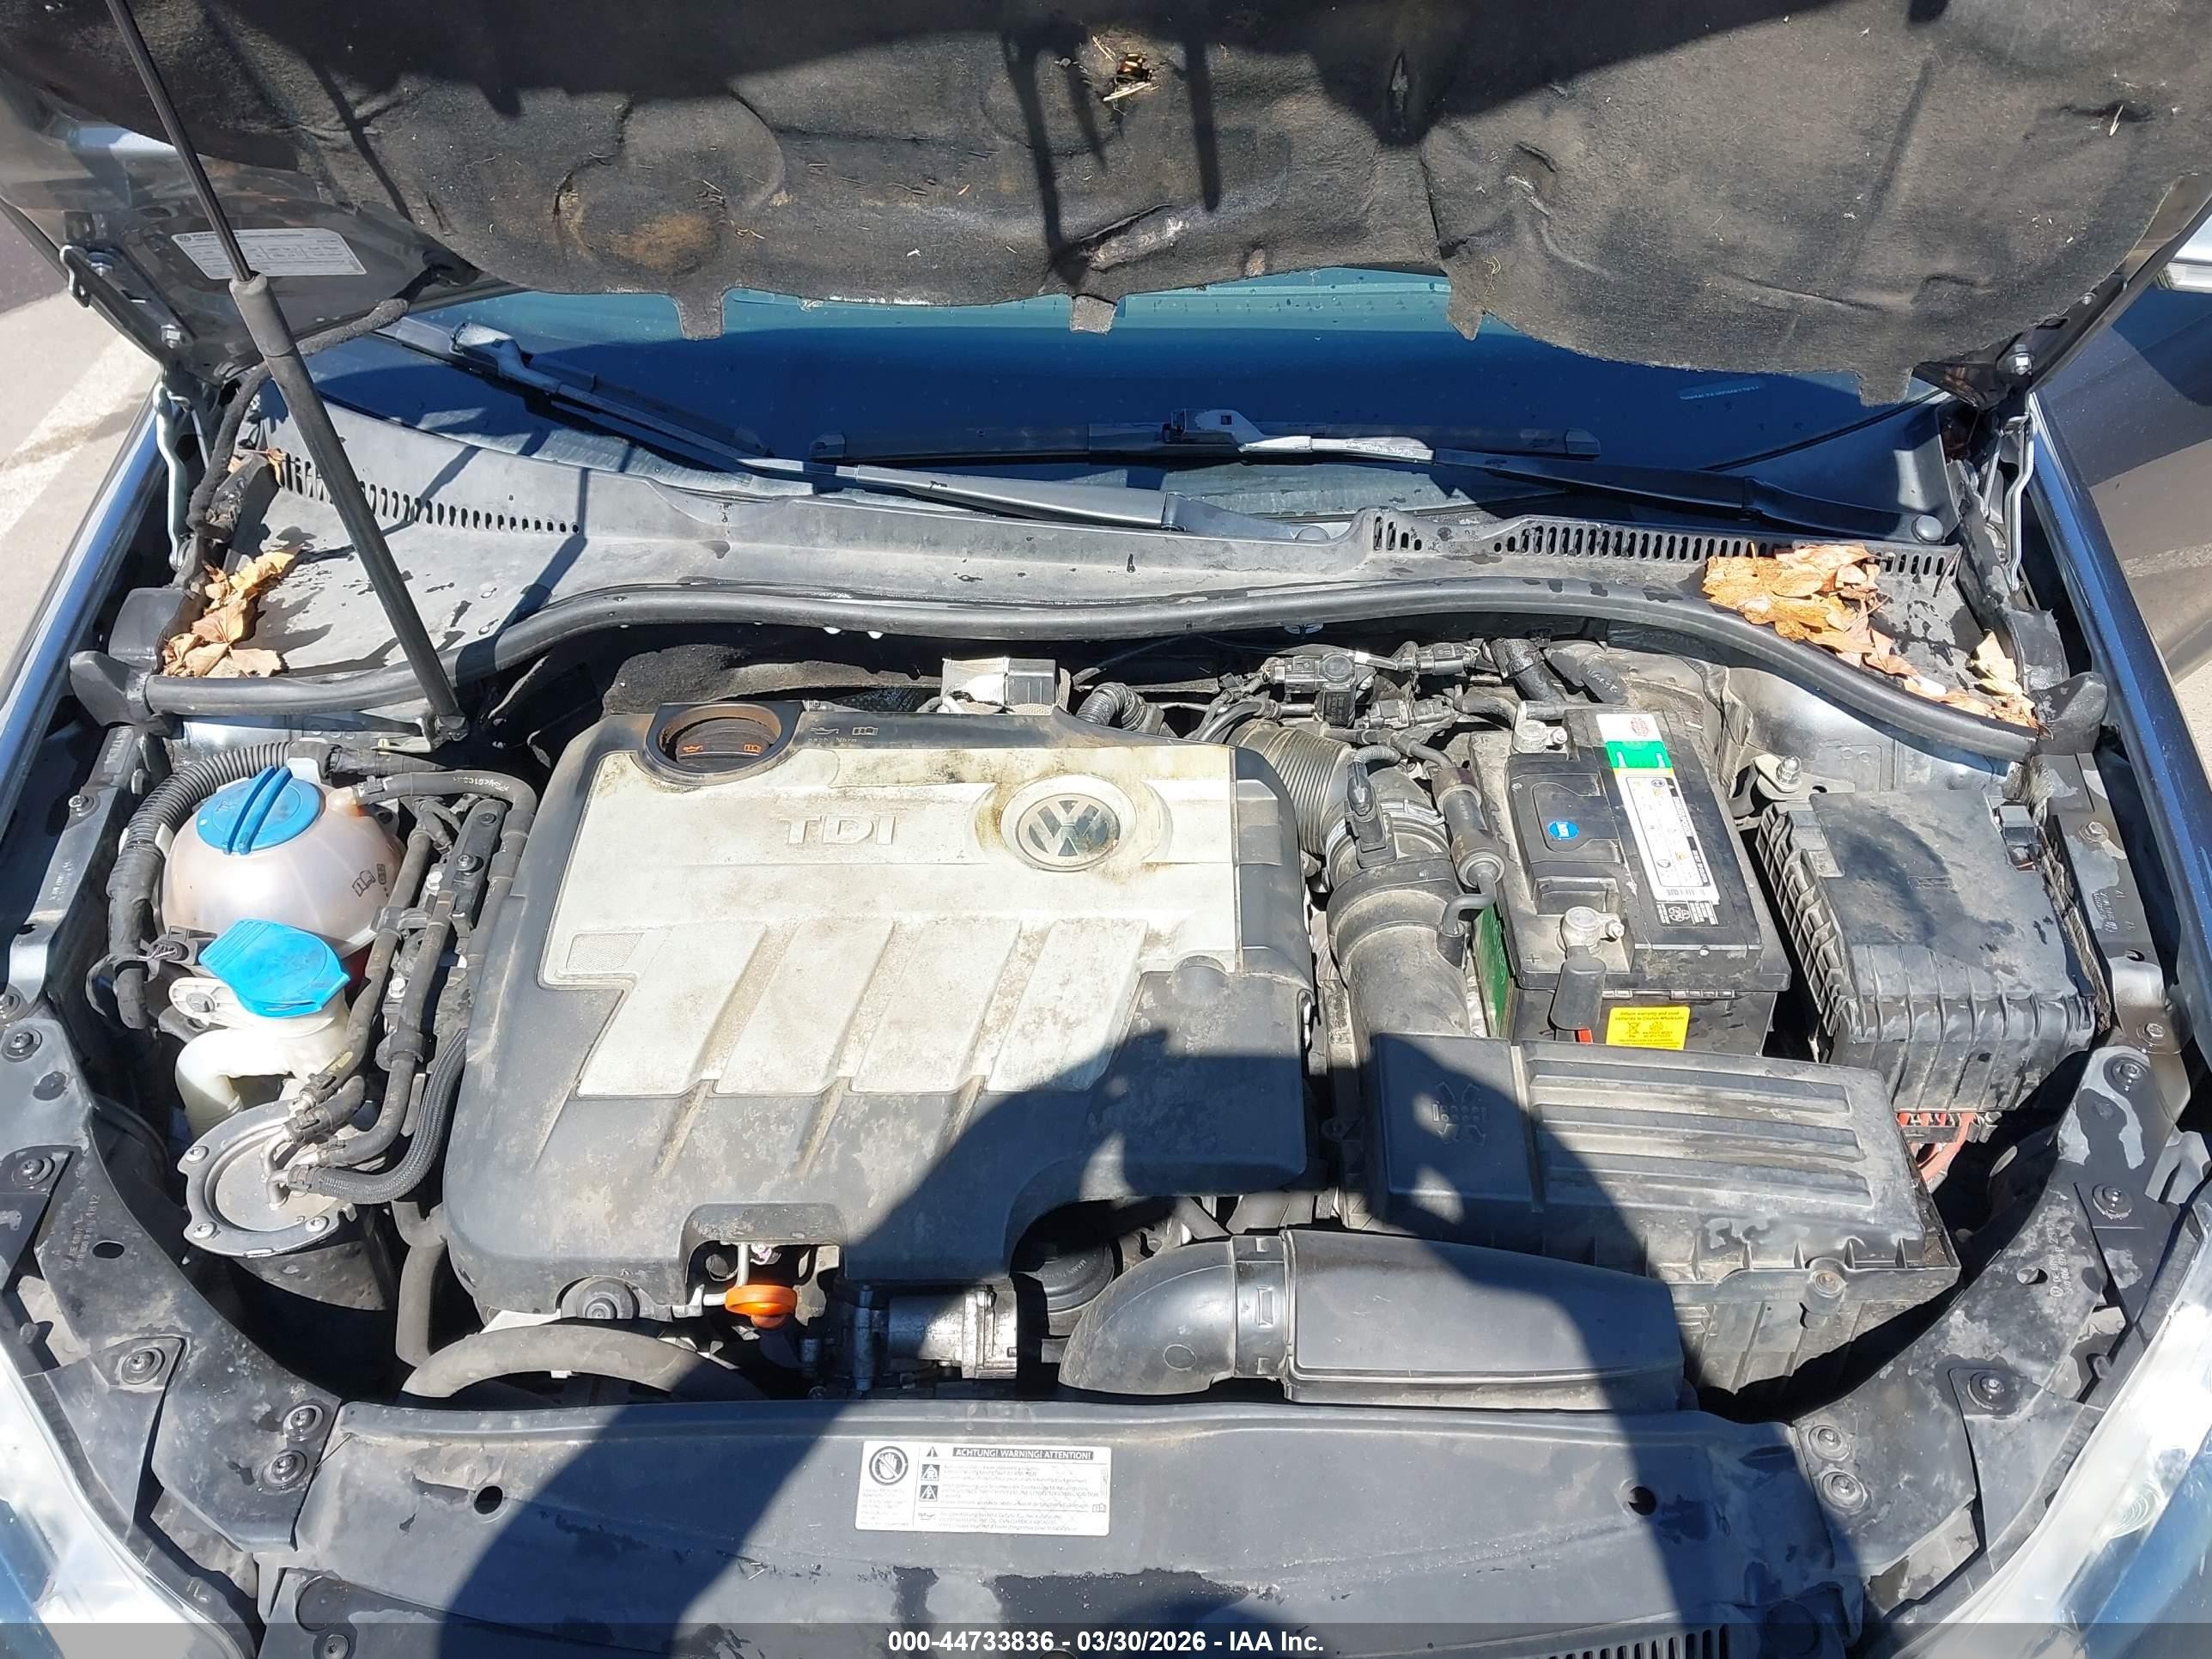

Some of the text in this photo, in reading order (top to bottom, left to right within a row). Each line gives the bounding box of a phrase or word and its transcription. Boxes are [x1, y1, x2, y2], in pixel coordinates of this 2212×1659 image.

[777, 814, 896, 845] TDI
[956, 1448, 1091, 1460] ACHTUNG! WARNING! ATTENTION!
